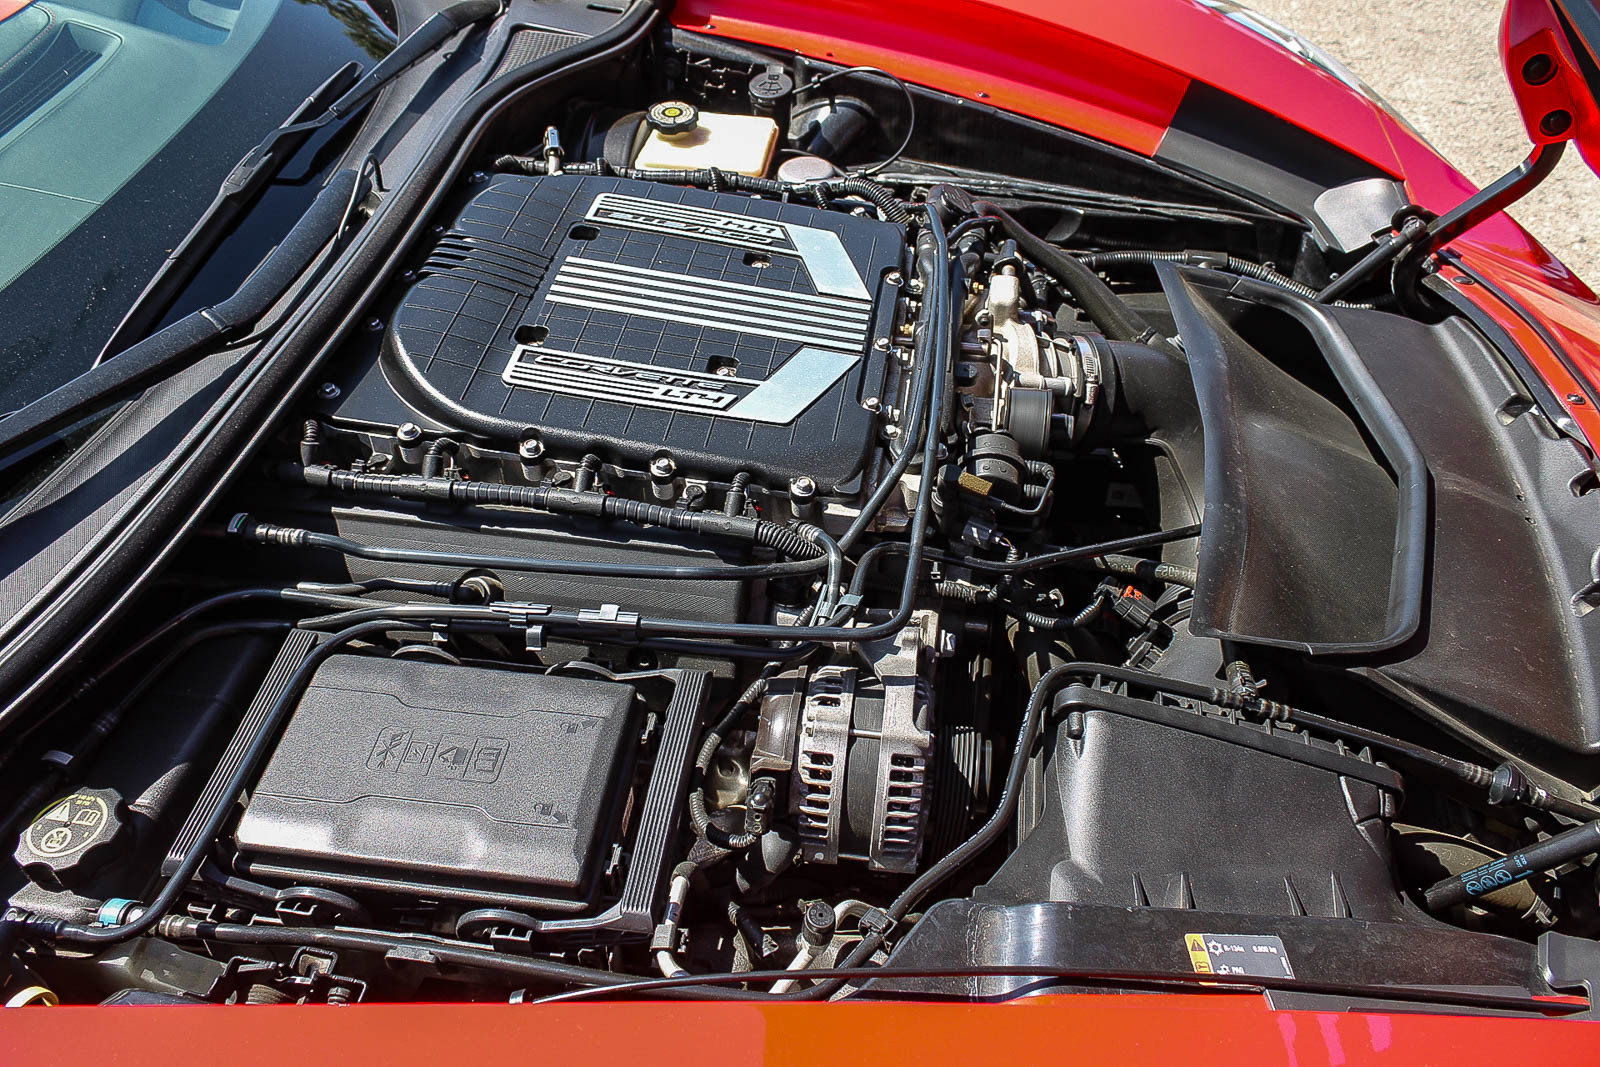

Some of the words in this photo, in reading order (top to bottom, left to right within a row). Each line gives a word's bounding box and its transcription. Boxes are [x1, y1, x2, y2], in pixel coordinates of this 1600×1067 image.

[606, 212, 774, 244] CORVETTE
[722, 220, 778, 234] LT4
[534, 354, 728, 390] CORVETTE
[660, 387, 725, 404] LT4
